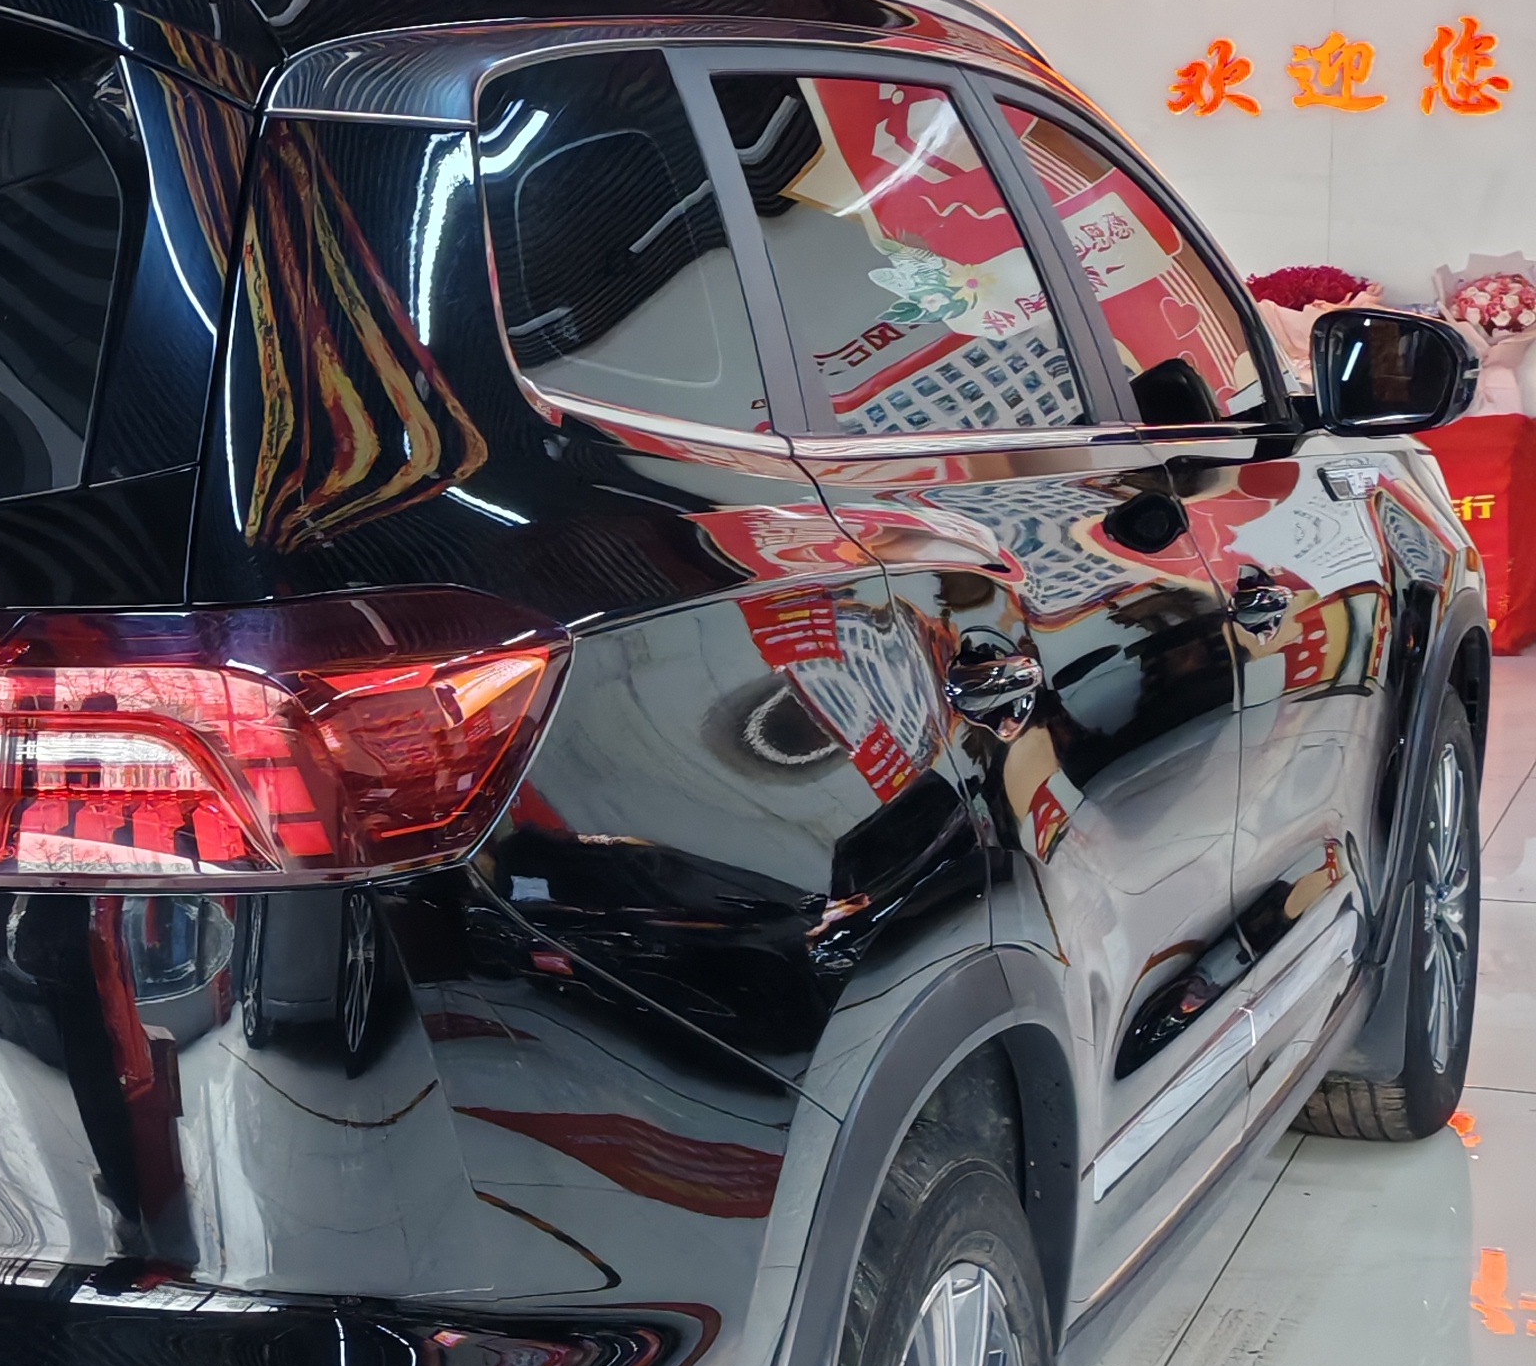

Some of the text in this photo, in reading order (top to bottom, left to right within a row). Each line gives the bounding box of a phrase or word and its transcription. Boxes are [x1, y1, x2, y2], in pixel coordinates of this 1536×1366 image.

[1167, 15, 1512, 116] 欢迎您
[1451, 493, 1496, 521] 行
